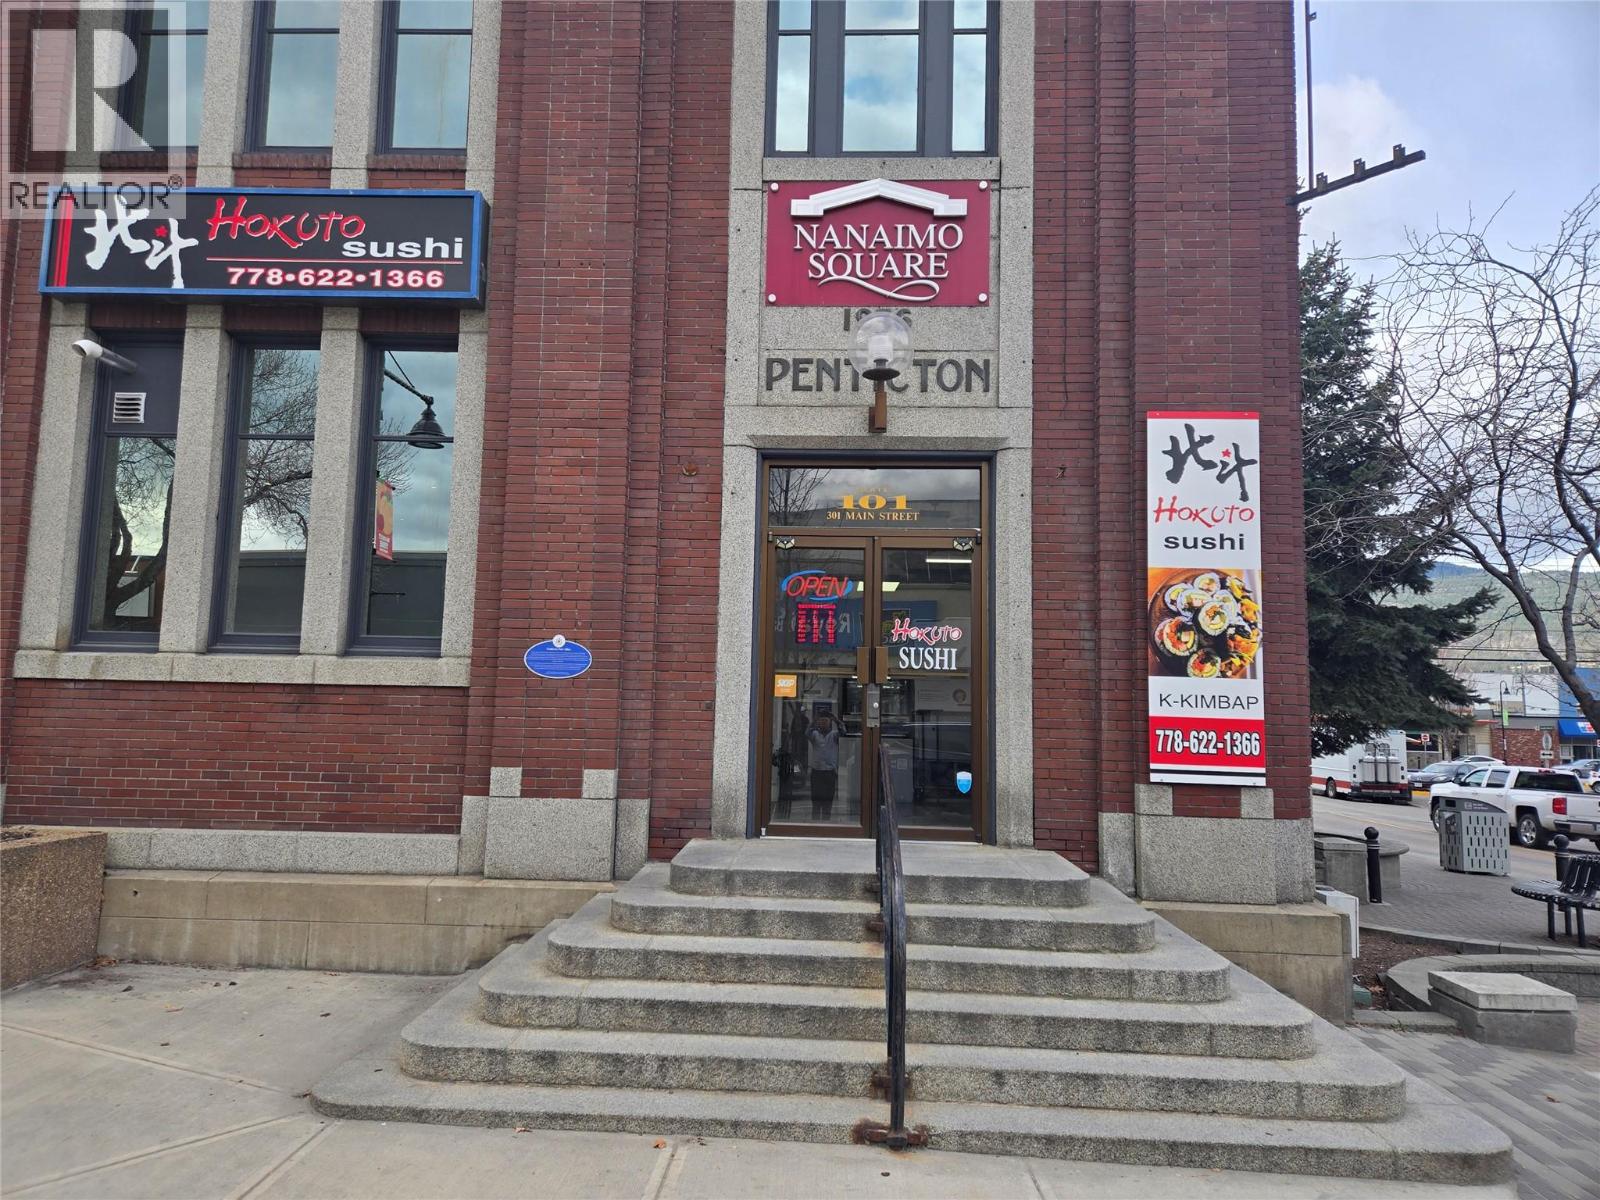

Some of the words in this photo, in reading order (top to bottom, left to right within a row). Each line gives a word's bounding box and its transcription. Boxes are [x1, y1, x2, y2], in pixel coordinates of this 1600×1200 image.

[793, 223, 964, 250] NANAIMO
[341, 237, 464, 259] sushi
[807, 252, 949, 301] SQUARE
[839, 494, 912, 510] 101
[826, 511, 841, 520] 301
[845, 511, 875, 521] MAIN
[879, 512, 920, 521] STREET
[1164, 533, 1244, 550] sushi
[787, 576, 848, 597] OPEN
[899, 646, 957, 671] SUSHI
[1159, 693, 1259, 710] K-KIMBAP
[1155, 728, 1261, 756] 778-622-1366
